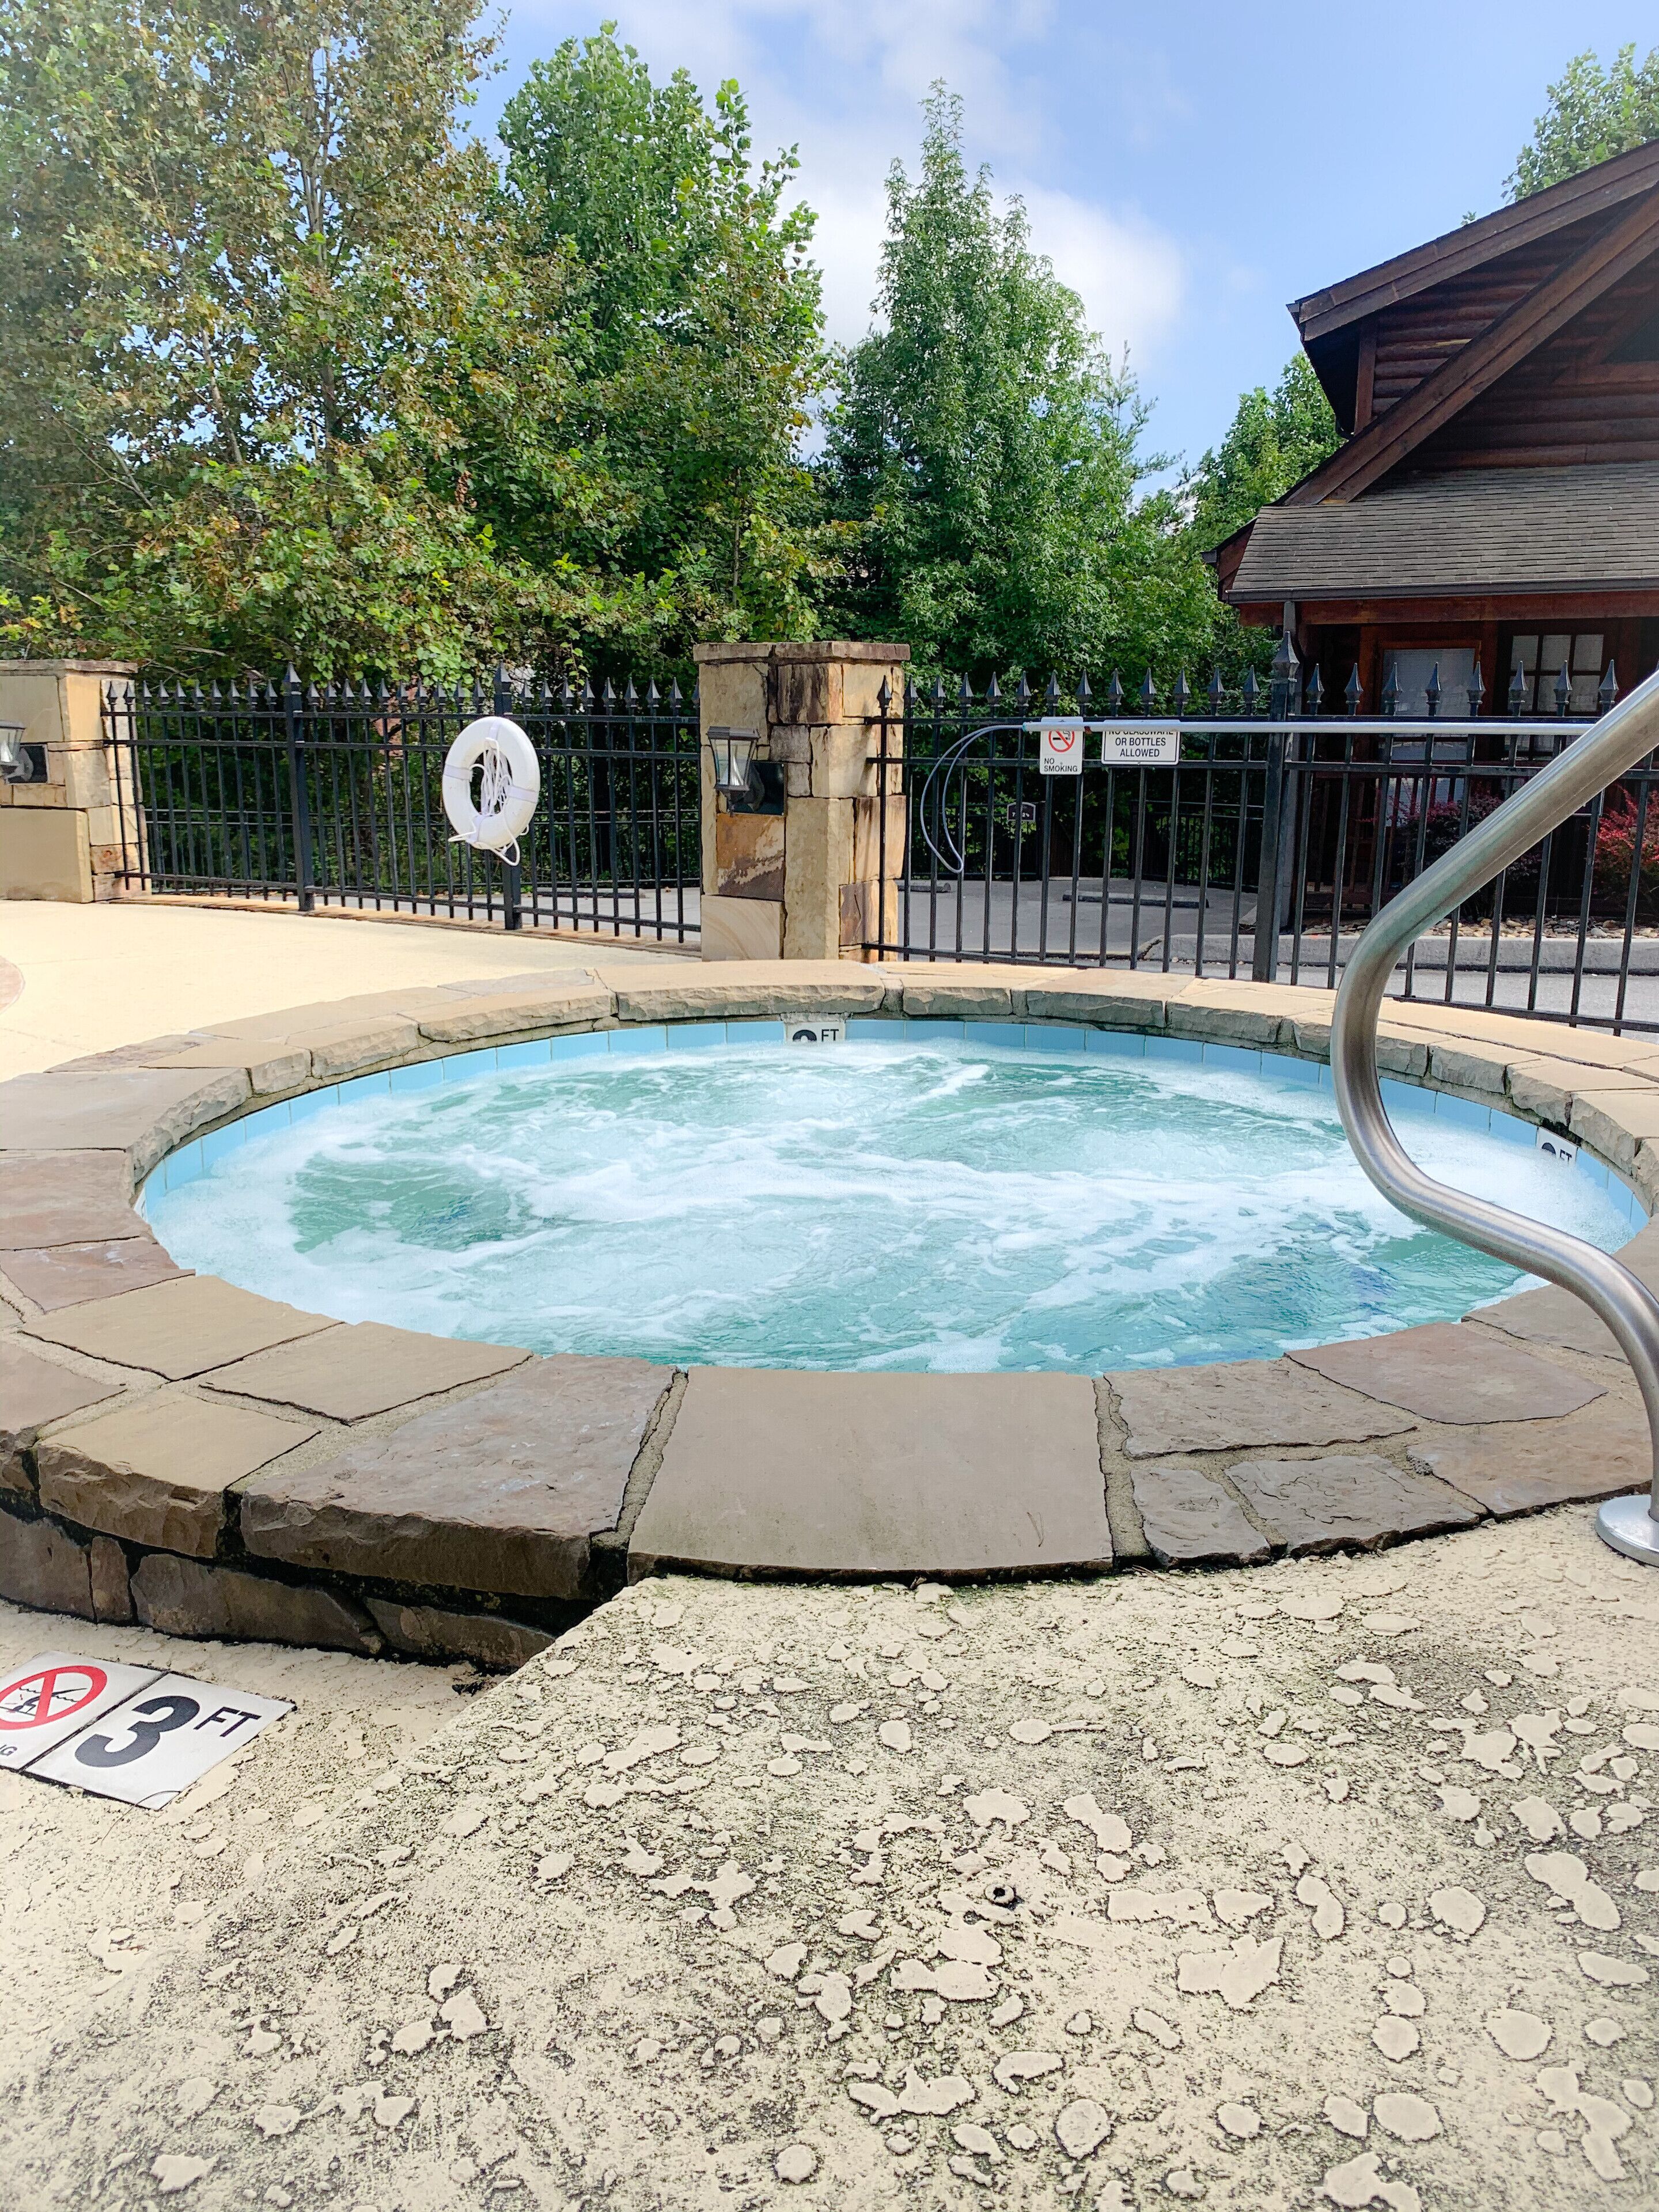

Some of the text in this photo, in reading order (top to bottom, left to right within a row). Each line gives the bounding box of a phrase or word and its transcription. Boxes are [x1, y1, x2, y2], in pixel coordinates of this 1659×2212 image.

[1115, 737, 1166, 746] OR BOTTLES
[1120, 748, 1160, 757] ALLOWED
[821, 1029, 839, 1041] FT
[75, 1695, 262, 1768] 3 FT
